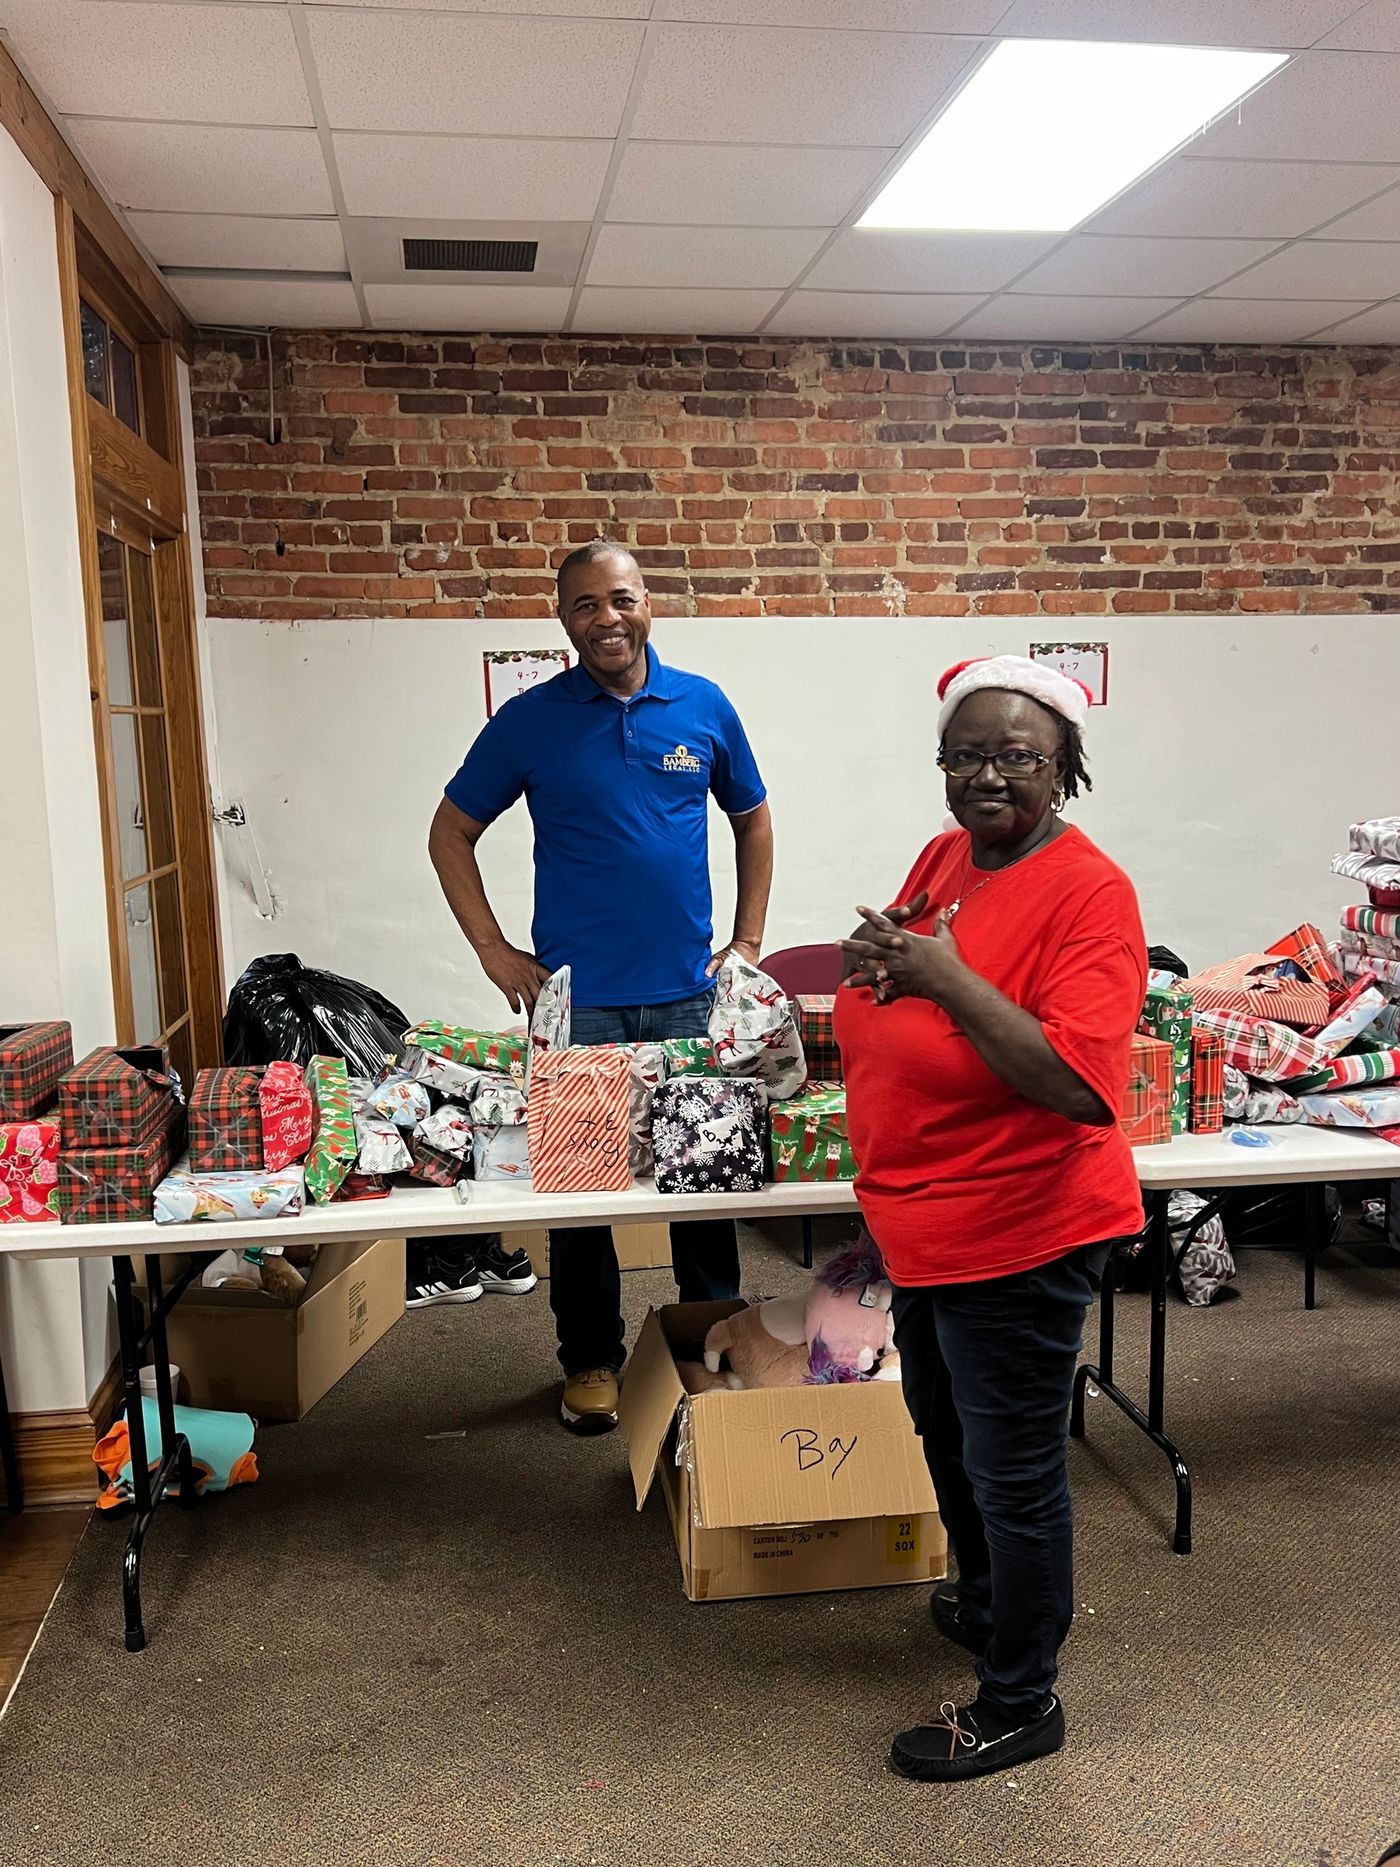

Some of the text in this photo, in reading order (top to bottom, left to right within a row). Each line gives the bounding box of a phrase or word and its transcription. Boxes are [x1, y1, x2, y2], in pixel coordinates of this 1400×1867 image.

[663, 757, 700, 768] BAMBERG
[899, 1523, 910, 1536] 22
[895, 1540, 915, 1551] SQX
